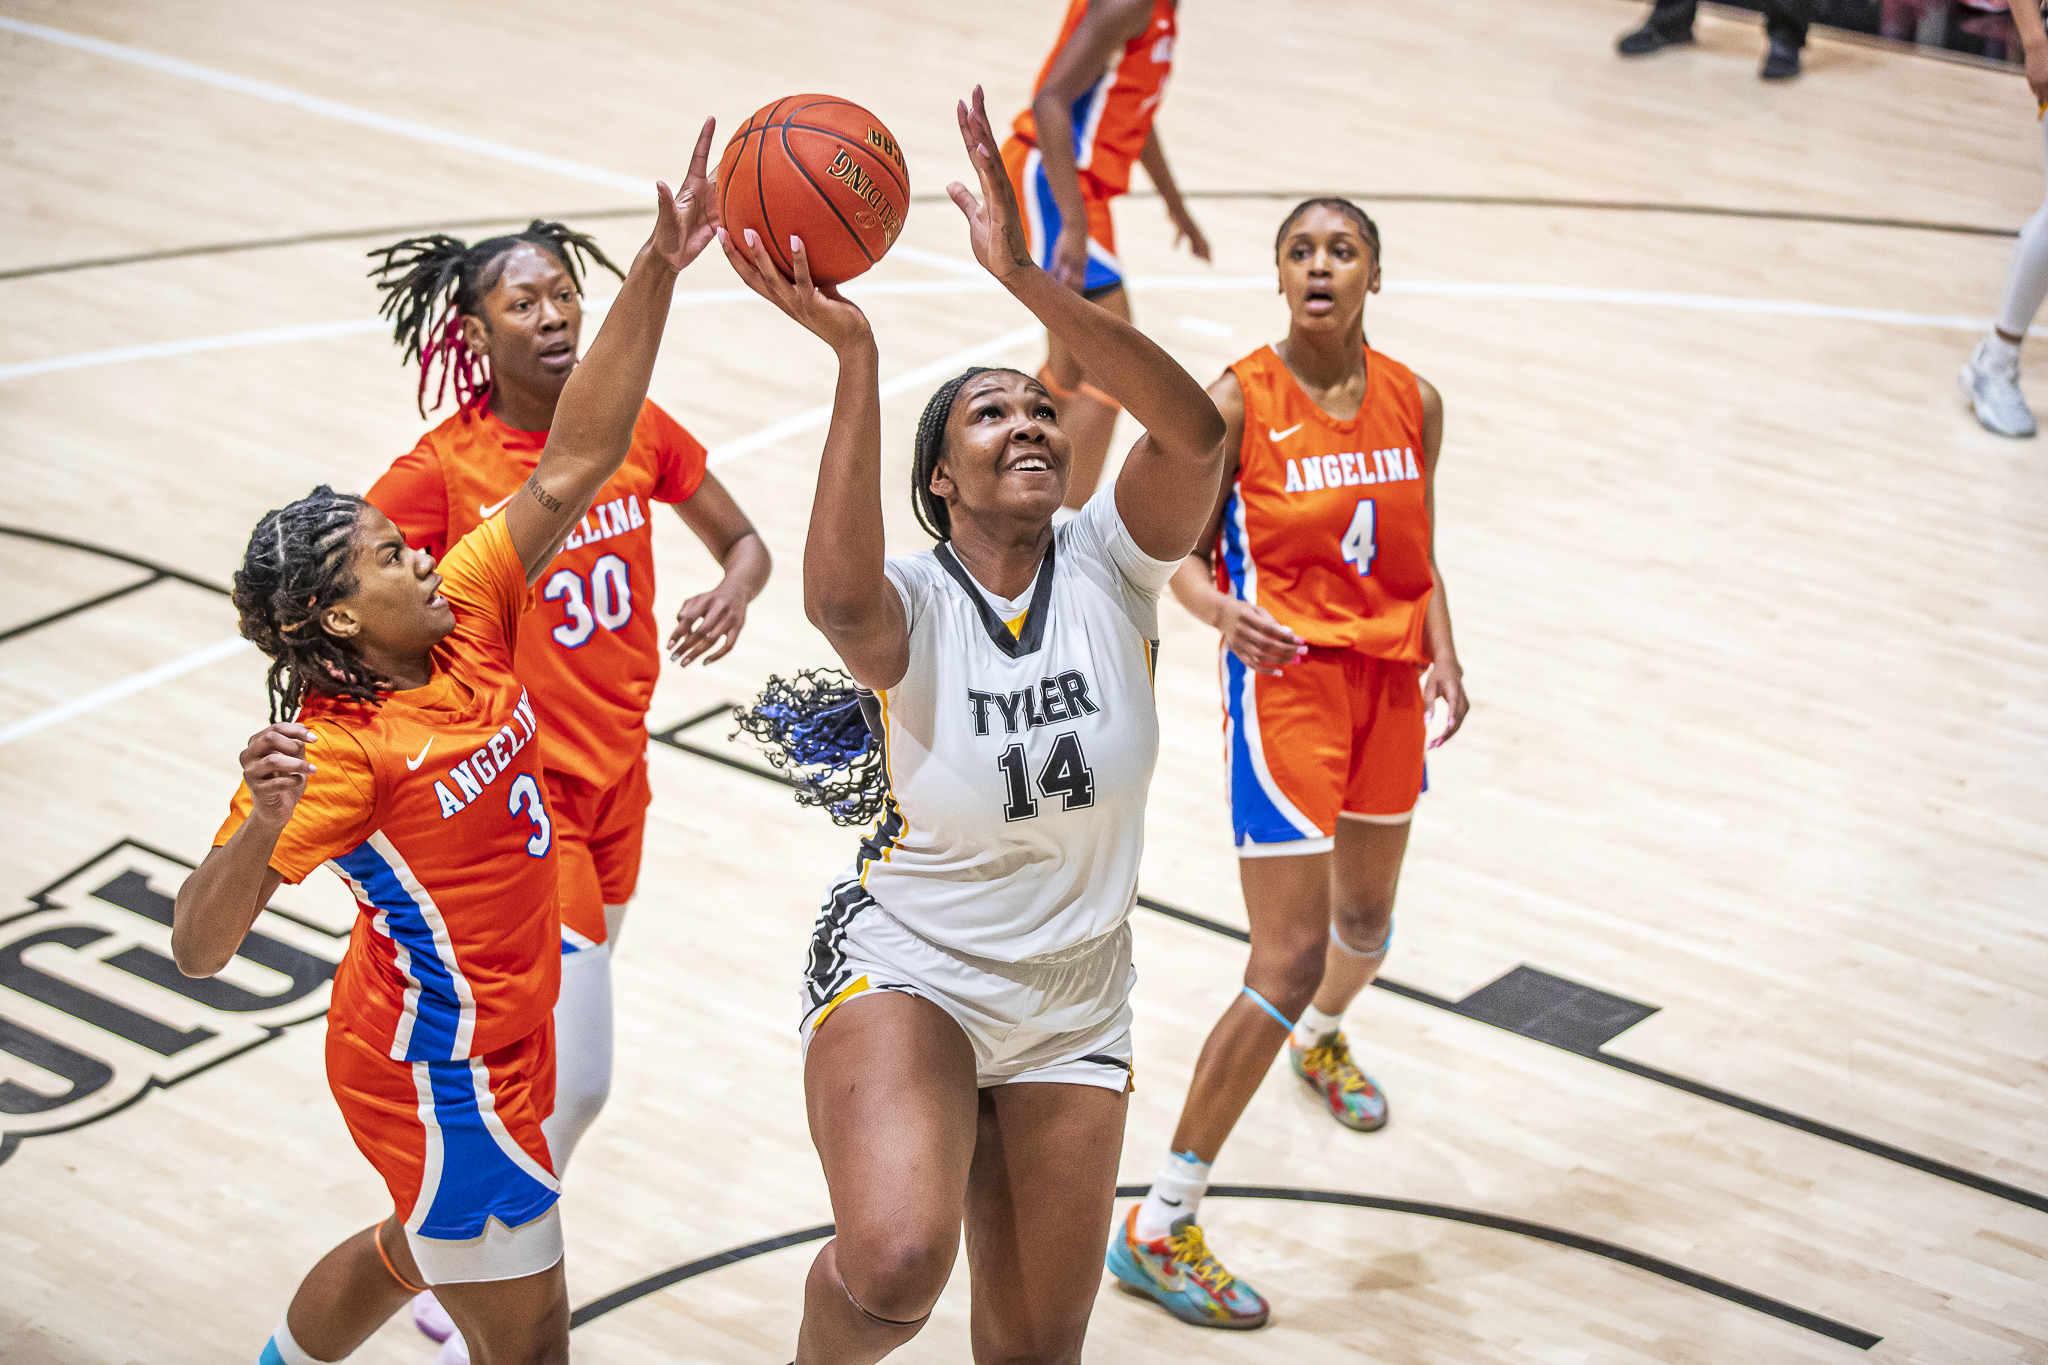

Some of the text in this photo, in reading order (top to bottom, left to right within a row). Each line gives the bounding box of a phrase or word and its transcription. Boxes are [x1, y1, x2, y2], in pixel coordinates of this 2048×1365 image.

[826, 148, 902, 249] PALDING
[1284, 446, 1420, 493] ANGELINA
[557, 494, 645, 554] ELINA
[1340, 498, 1378, 577] 4
[544, 553, 632, 649] 30
[968, 669, 1101, 736] TYLER
[507, 772, 551, 859] 3
[997, 730, 1095, 823] 14
